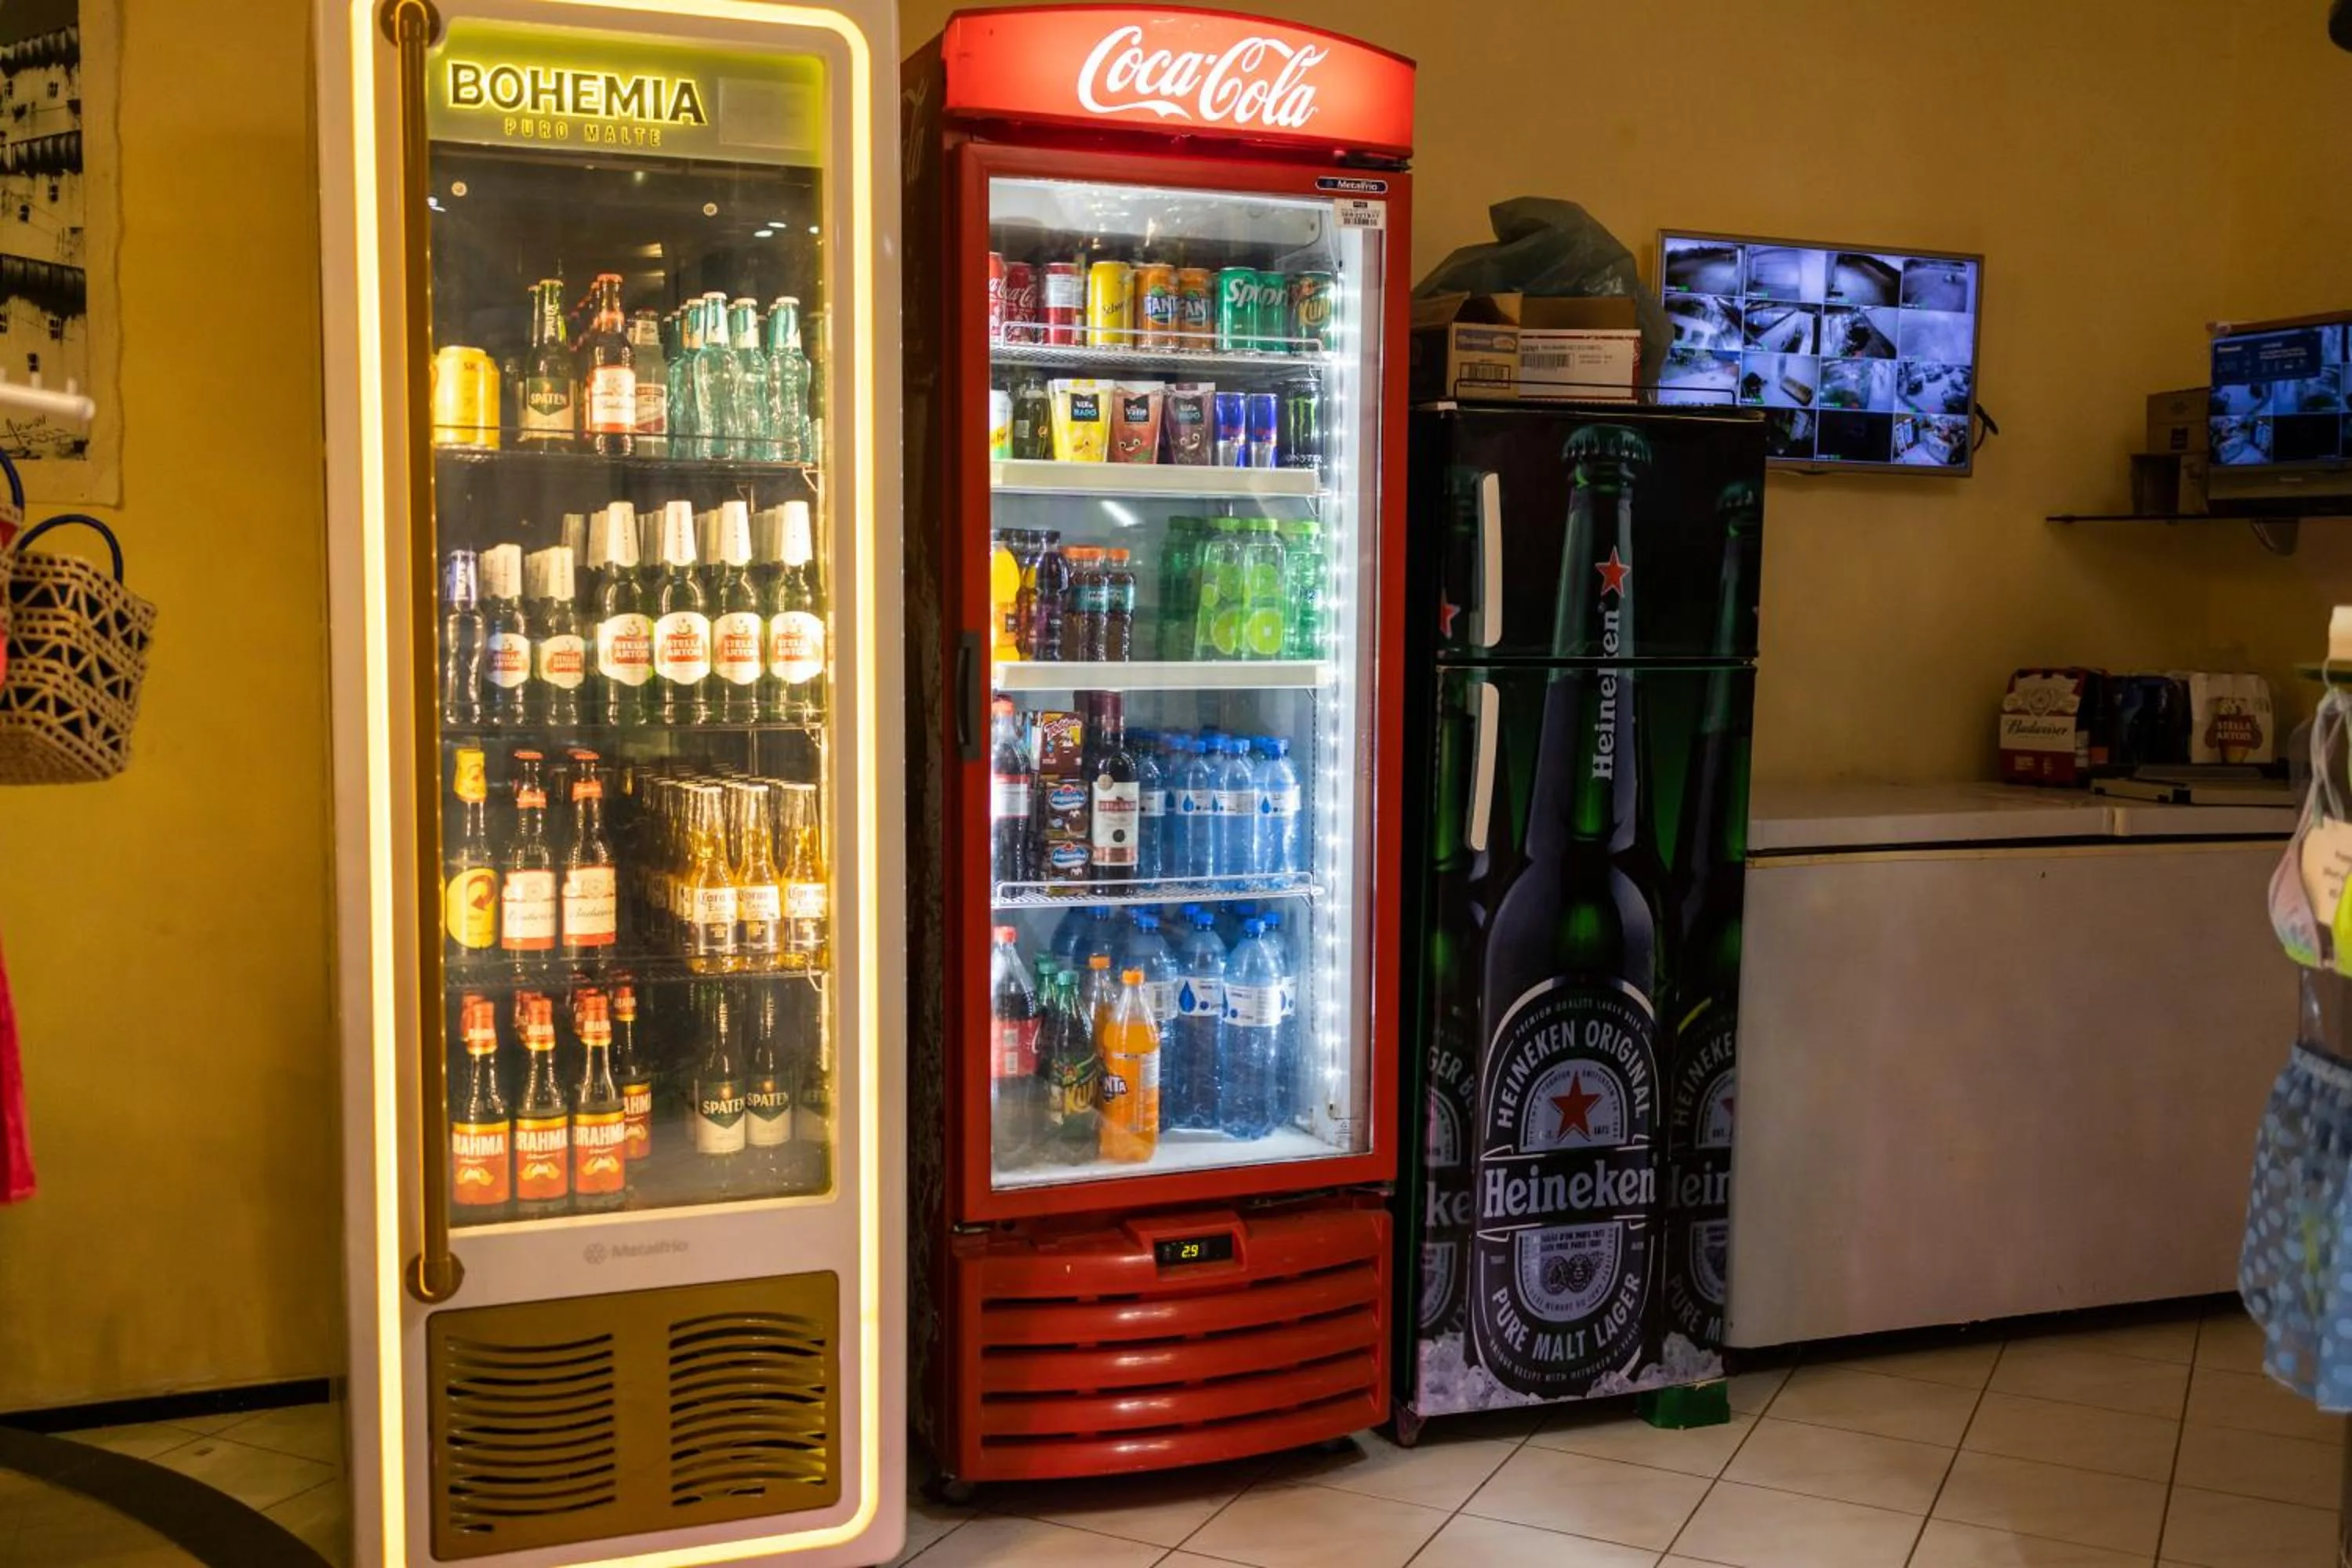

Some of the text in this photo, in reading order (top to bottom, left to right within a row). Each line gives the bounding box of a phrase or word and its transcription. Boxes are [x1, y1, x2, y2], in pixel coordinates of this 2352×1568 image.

[448, 60, 707, 125] BOHEMIA
[1077, 25, 1329, 129] Coca-Cola
[504, 118, 662, 147] PURO MALTE
[1144, 295, 1176, 315] FANT
[530, 392, 568, 406] SPATEN
[1497, 1018, 1576, 1129] HEINEKEN
[1584, 1019, 1650, 1120] ORIGINAL
[1483, 1159, 1657, 1218] Heineken
[1492, 1272, 1641, 1362] PURE MALT LAGER
